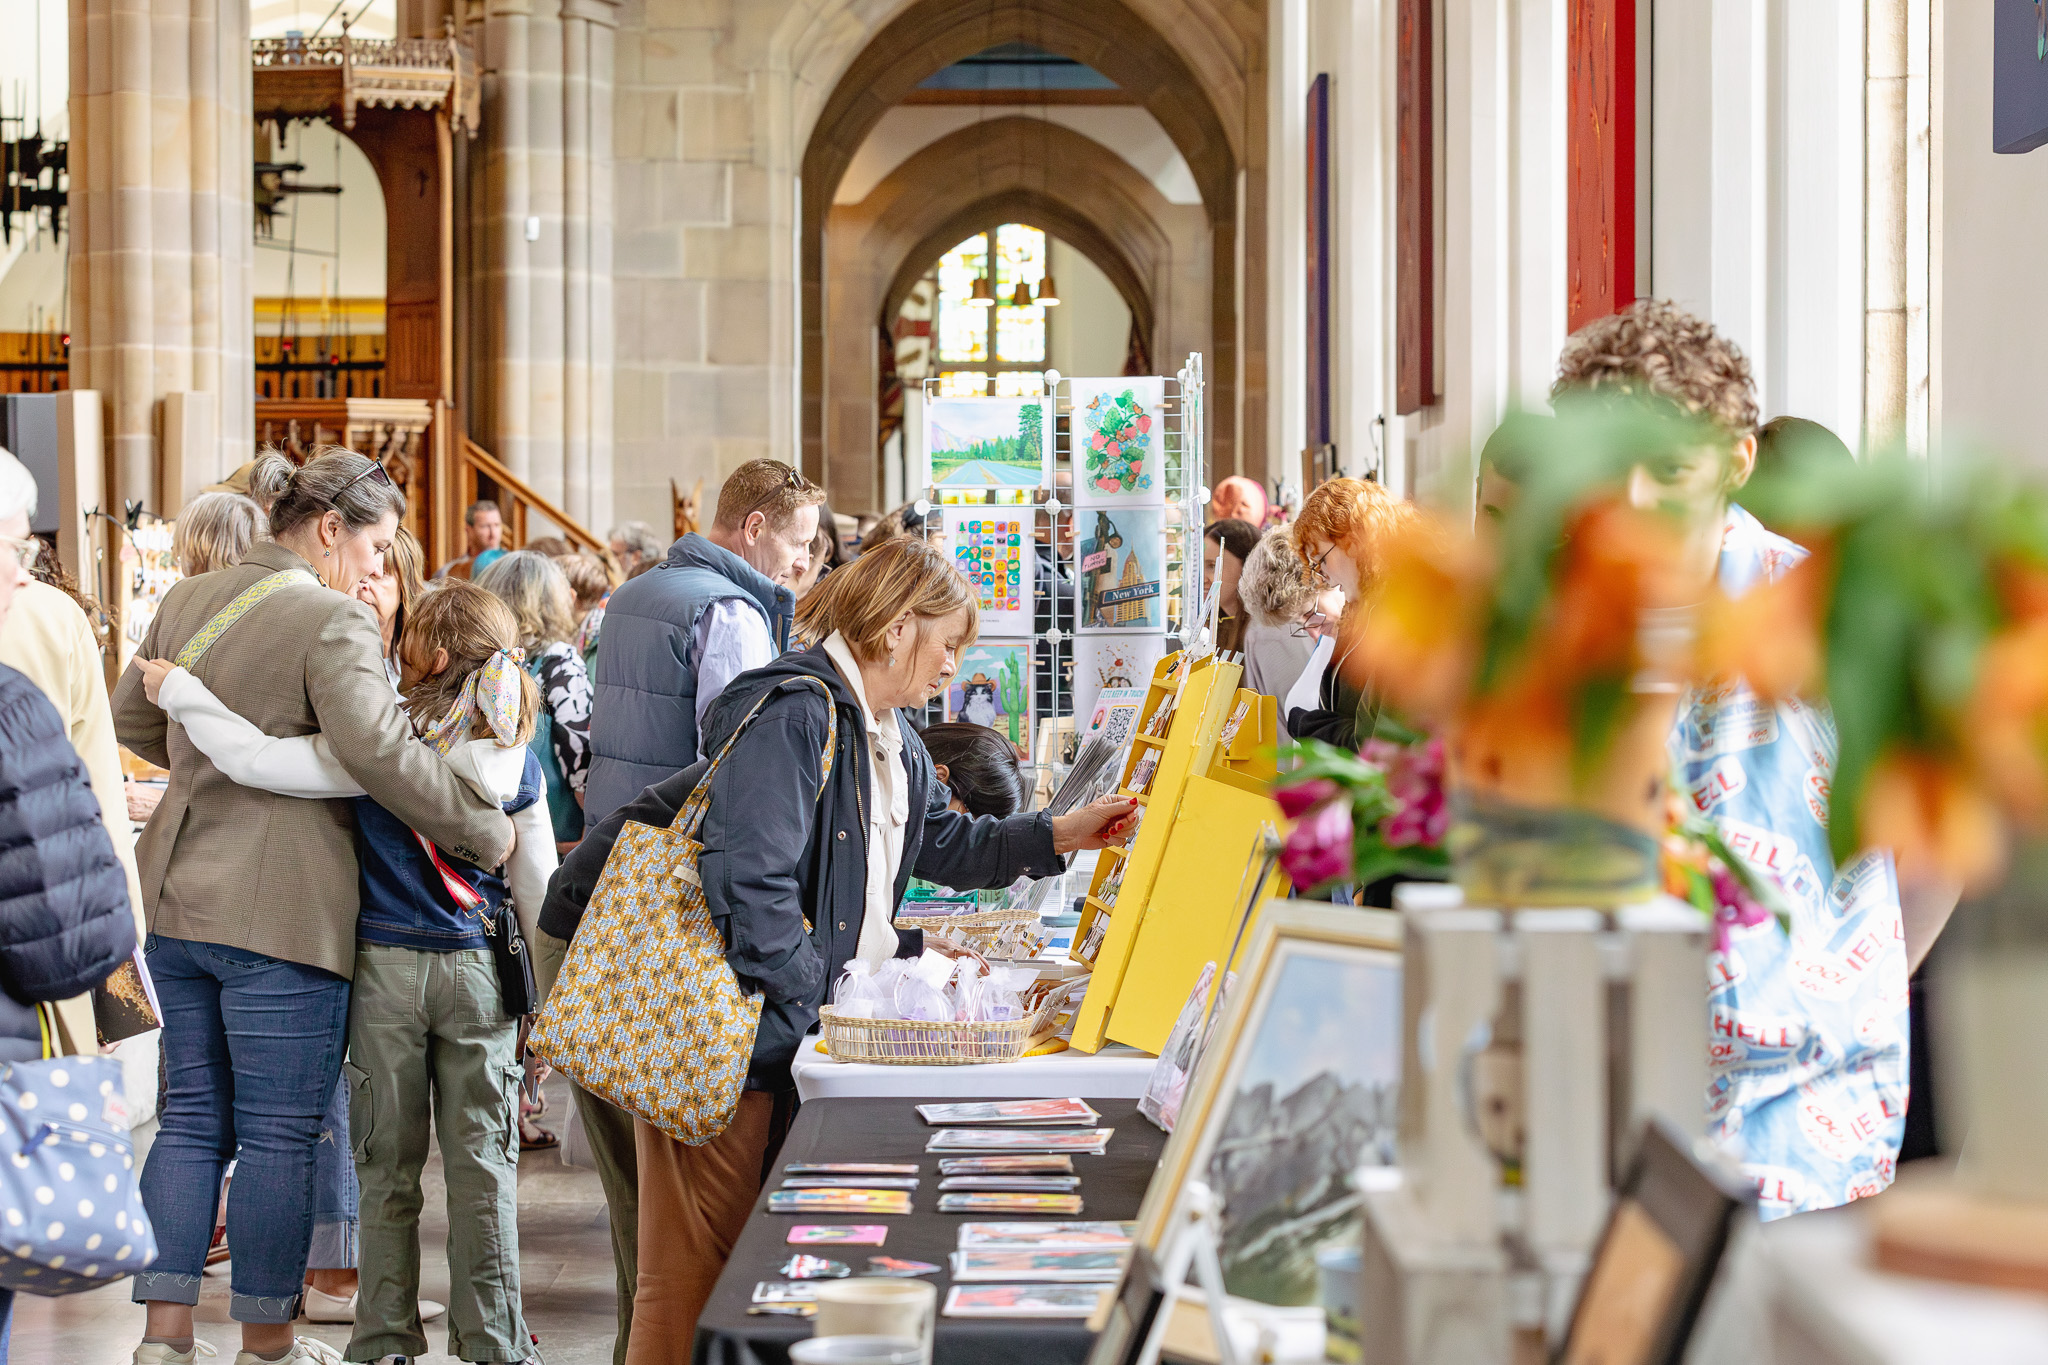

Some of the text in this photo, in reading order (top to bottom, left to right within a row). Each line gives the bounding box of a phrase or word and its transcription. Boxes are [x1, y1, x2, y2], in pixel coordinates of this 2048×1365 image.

[1112, 584, 1155, 600] New York
[1721, 829, 1781, 872] ELL
[1713, 1014, 1798, 1048] HELL
